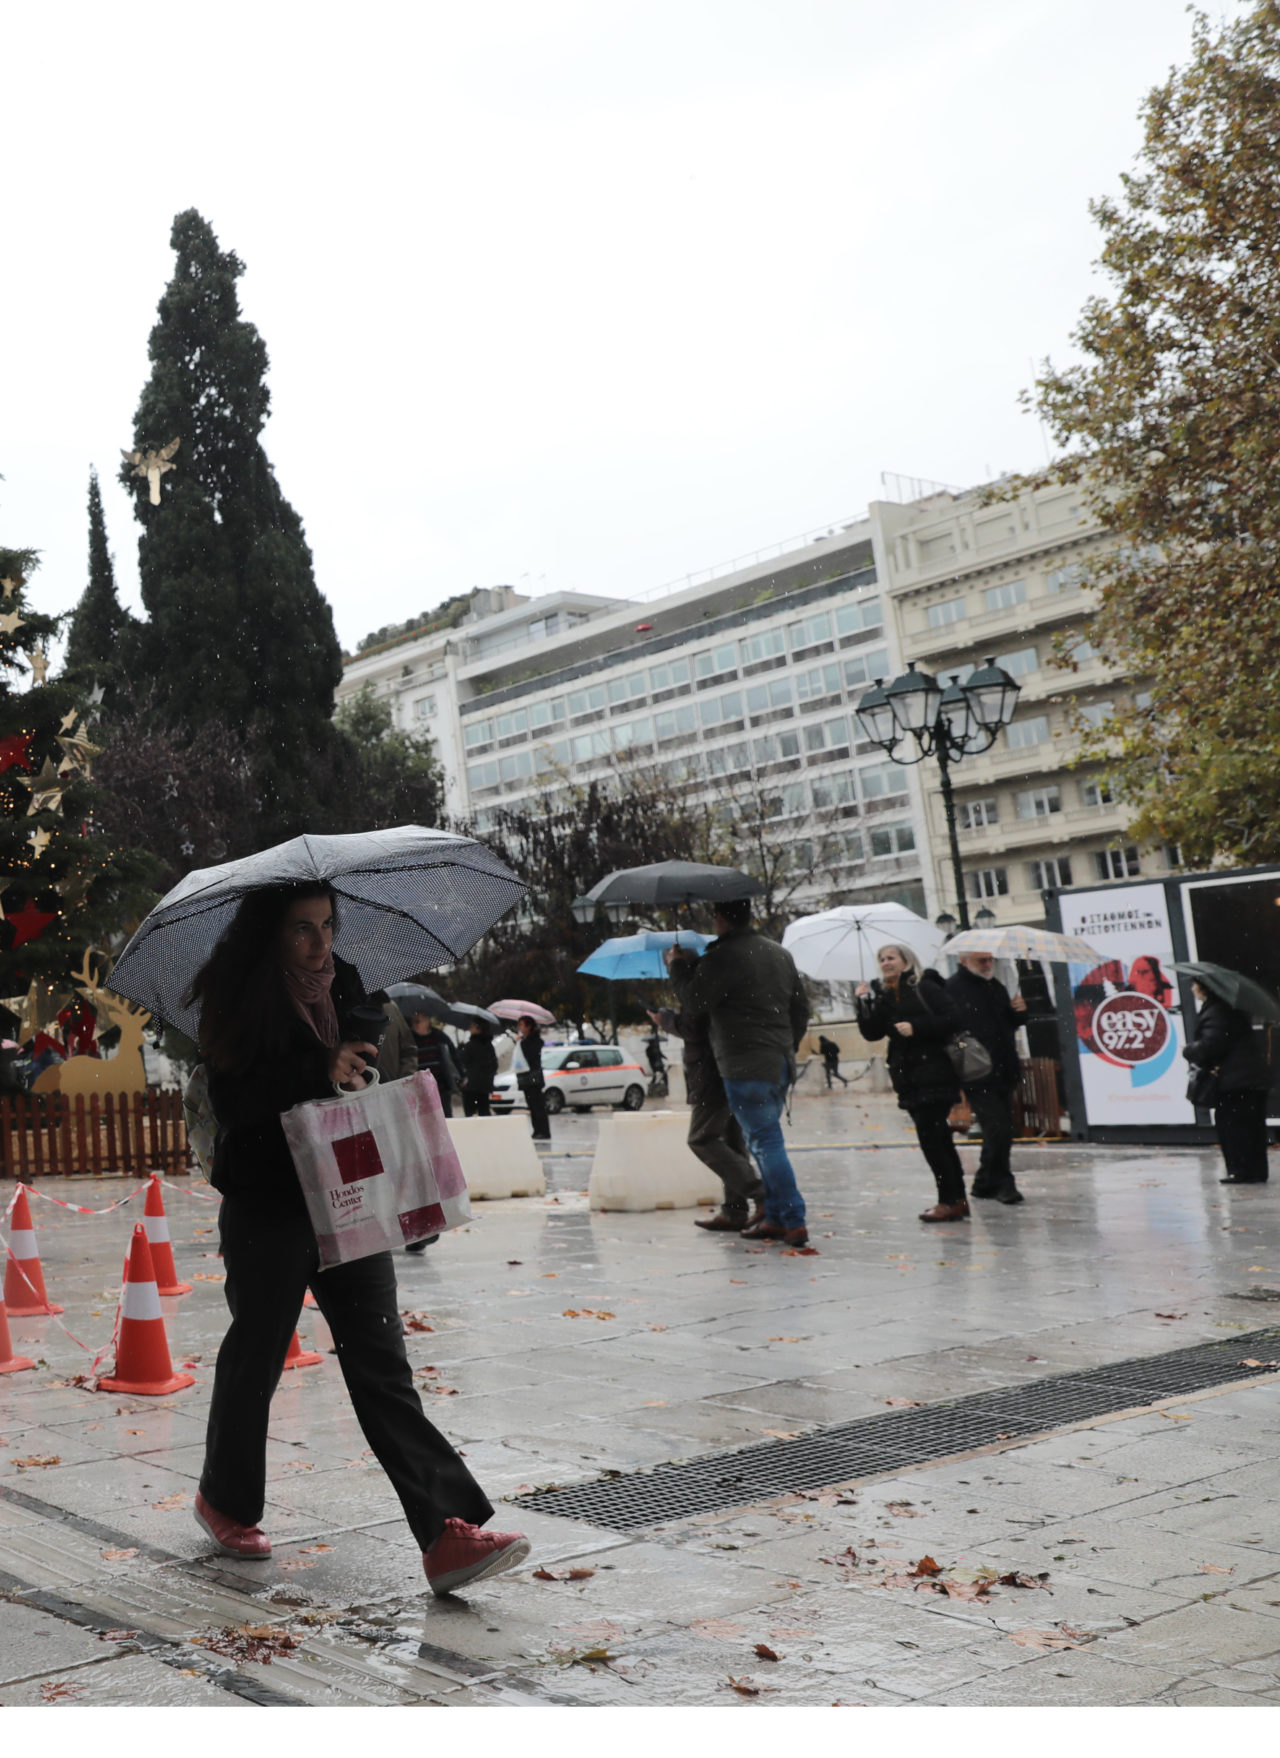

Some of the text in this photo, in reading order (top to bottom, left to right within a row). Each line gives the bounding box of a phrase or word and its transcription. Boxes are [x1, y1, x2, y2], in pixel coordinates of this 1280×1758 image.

[1100, 1008, 1159, 1038] easy
[1102, 1030, 1145, 1050] 97.2
[329, 1185, 364, 1201] Hondos
[332, 1195, 362, 1209] Center
